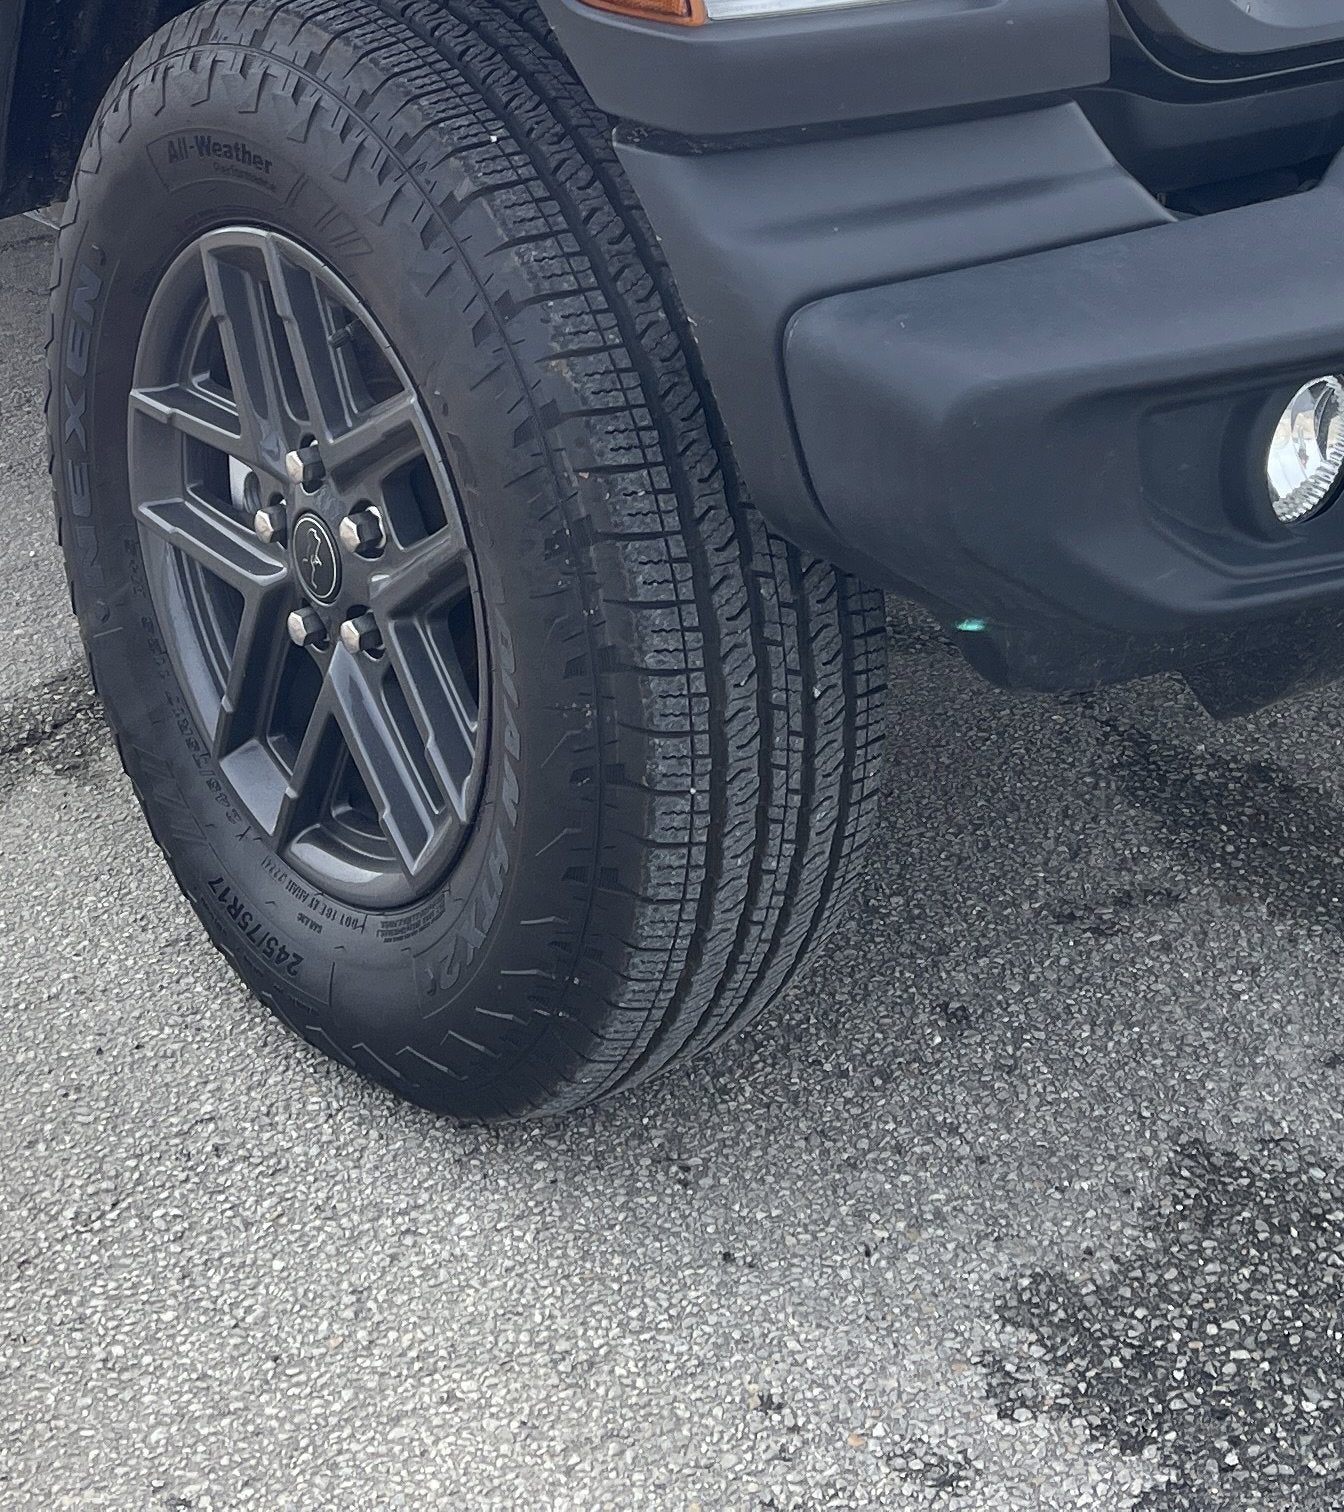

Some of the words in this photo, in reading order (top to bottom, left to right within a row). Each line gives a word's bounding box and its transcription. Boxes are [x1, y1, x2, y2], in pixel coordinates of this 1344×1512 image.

[167, 136, 273, 174] All-Weather
[66, 263, 106, 589] NEXEN
[207, 876, 304, 978] 245/75R17
